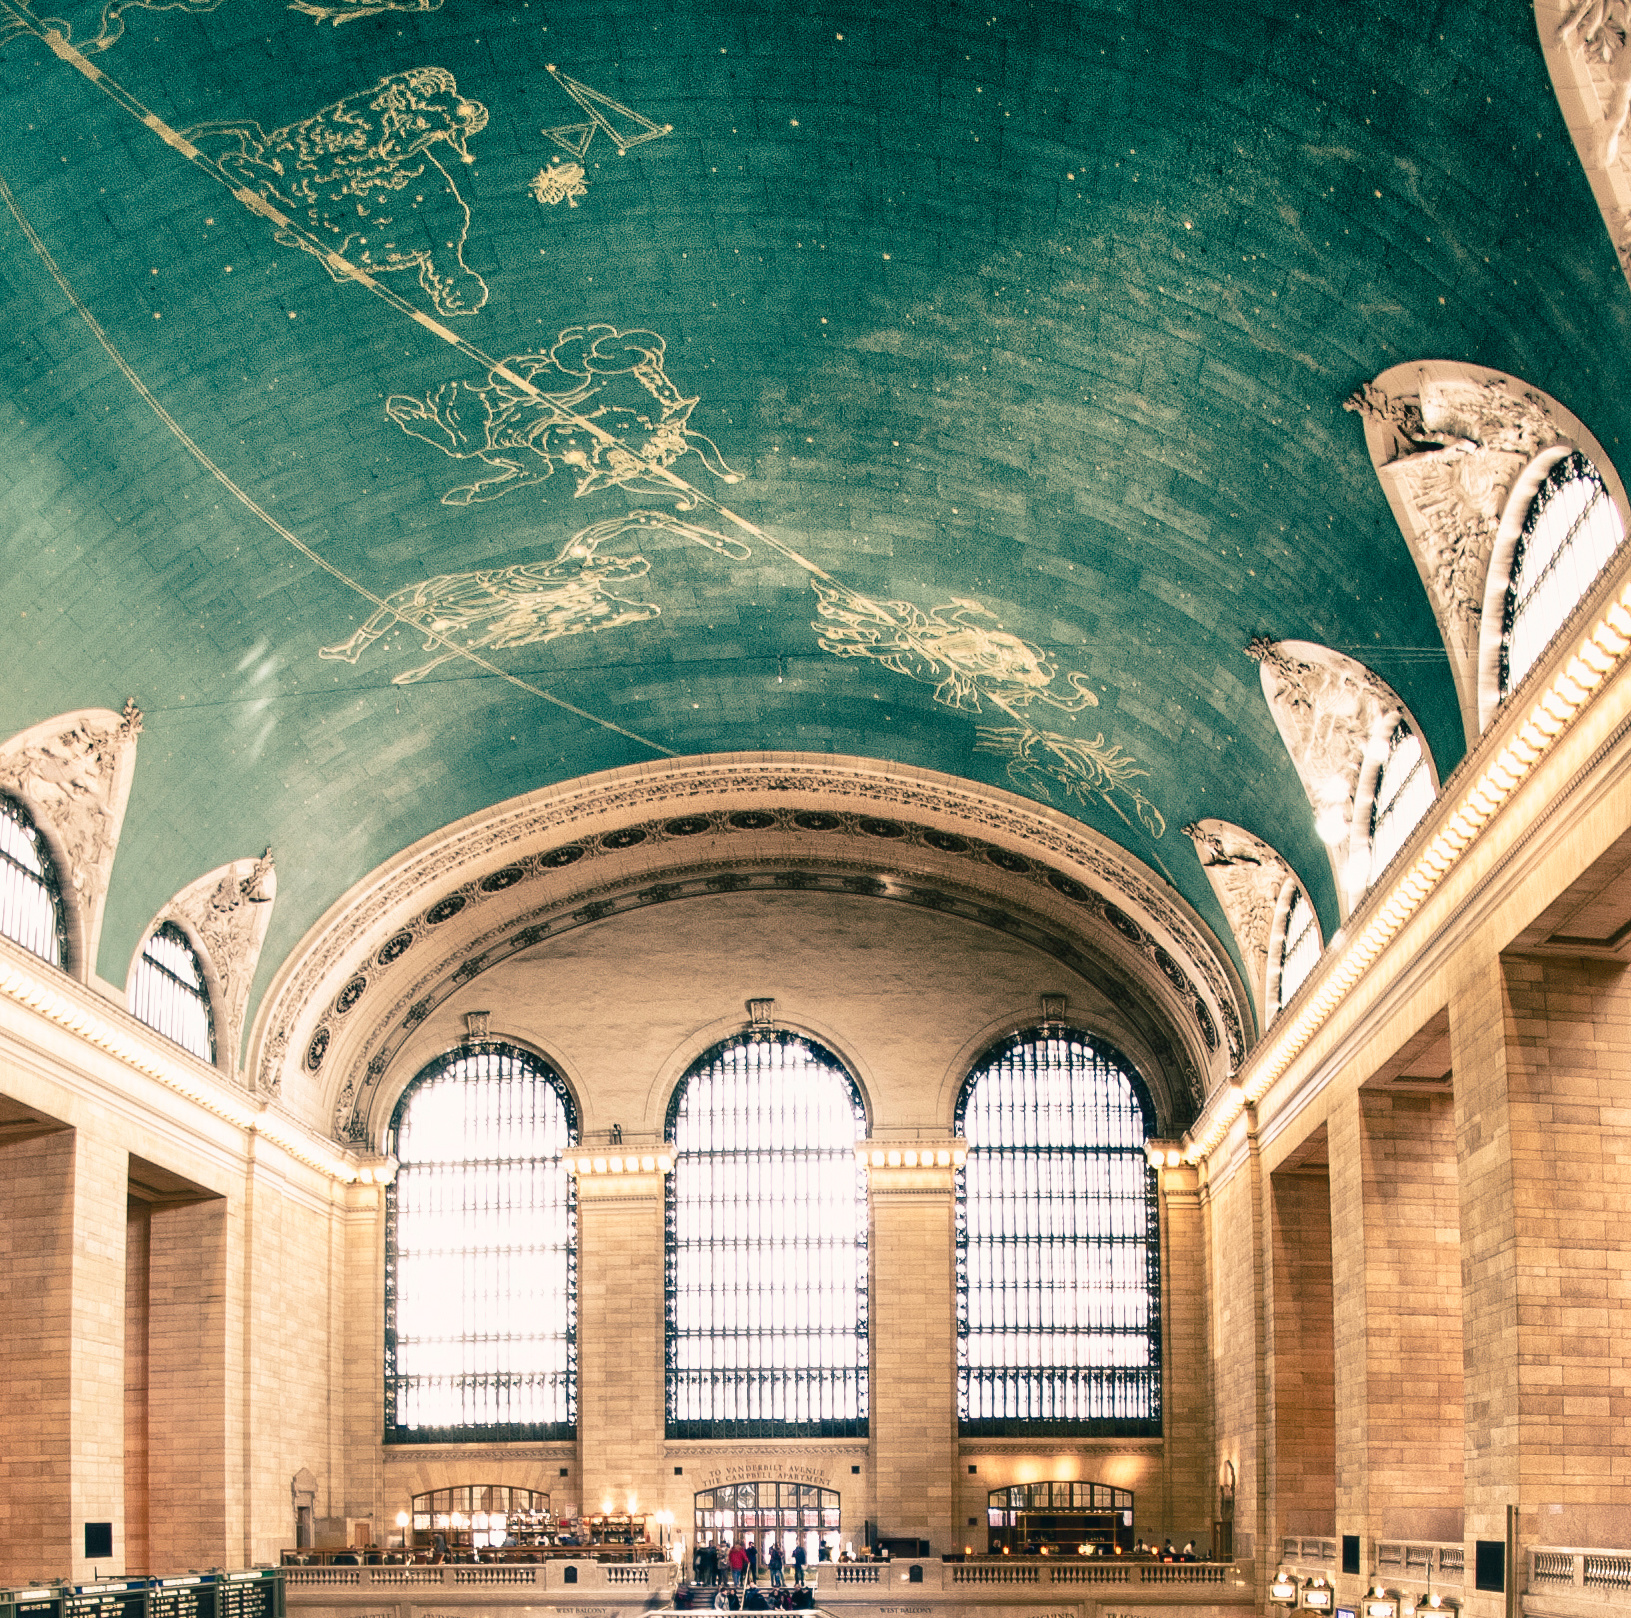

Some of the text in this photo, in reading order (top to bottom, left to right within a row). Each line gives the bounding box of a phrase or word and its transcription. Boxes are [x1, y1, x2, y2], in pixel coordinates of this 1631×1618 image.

[726, 1464, 783, 1473] VANDERBILT
[790, 1466, 825, 1477] AVENUE
[725, 1472, 772, 1481] CAMPBELL
[779, 1473, 831, 1486] APARTMENT
